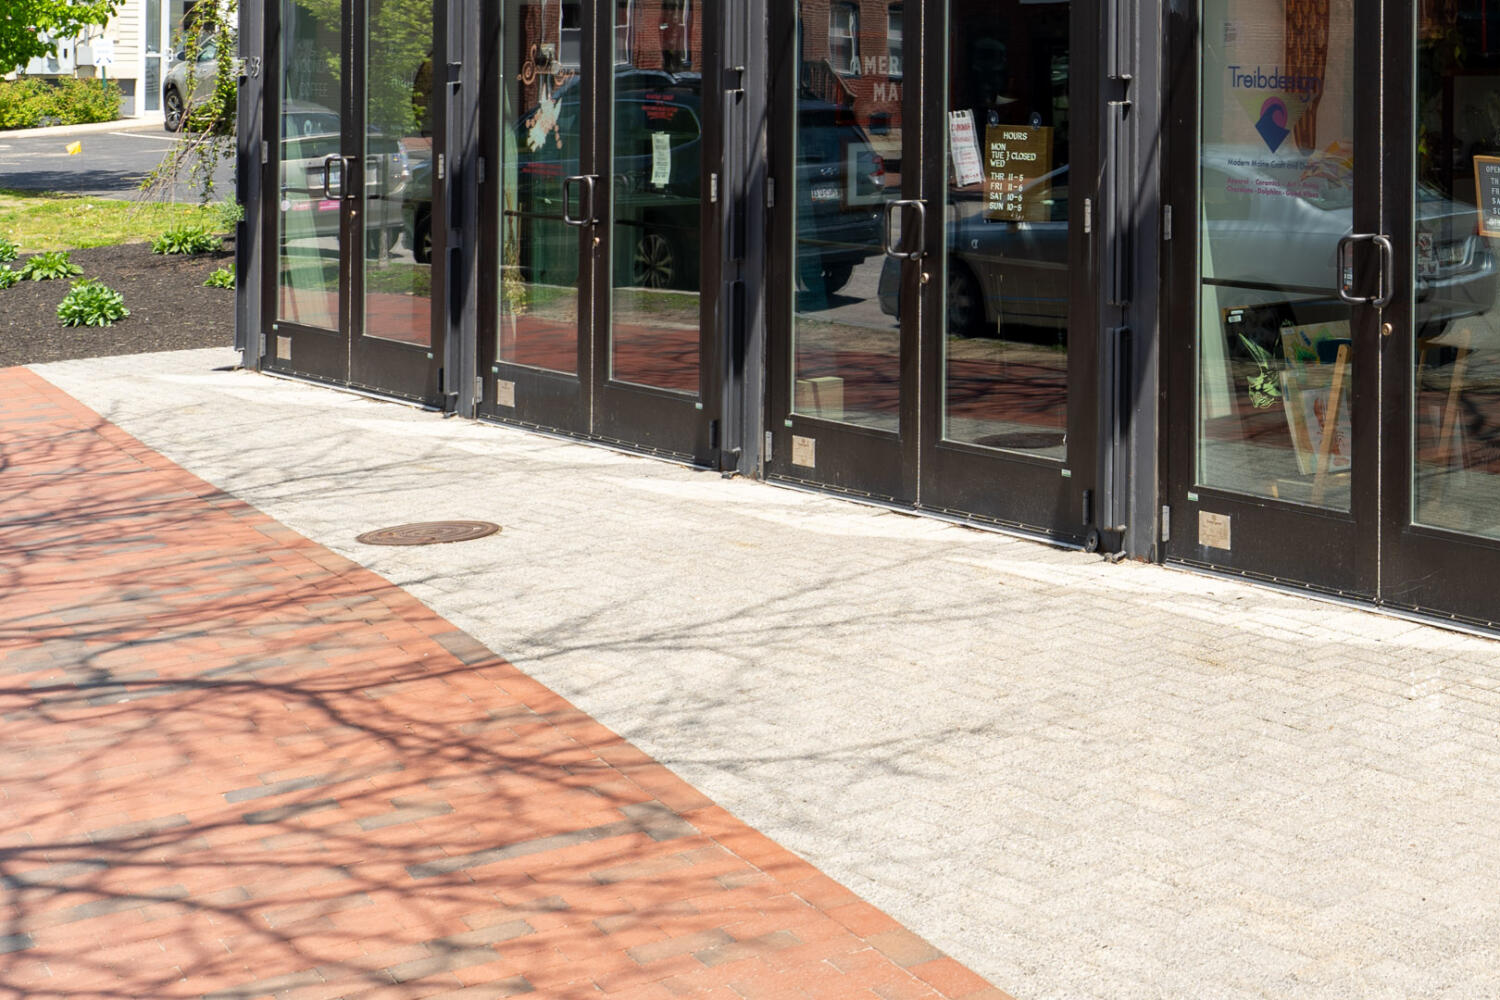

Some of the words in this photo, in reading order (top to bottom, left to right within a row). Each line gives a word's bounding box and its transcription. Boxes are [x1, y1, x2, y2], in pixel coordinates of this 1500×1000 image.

[1003, 131, 1029, 141] HOURS
[990, 142, 1007, 151] MON
[991, 151, 1005, 159] TUE
[1010, 152, 1037, 161] CLOSED
[990, 159, 1006, 168] WED
[990, 172, 1005, 181] THR
[990, 182, 1003, 190] FRI
[989, 192, 1003, 201] SAT
[1491, 197, 1500, 205] SA
[989, 202, 1004, 211] SUN
